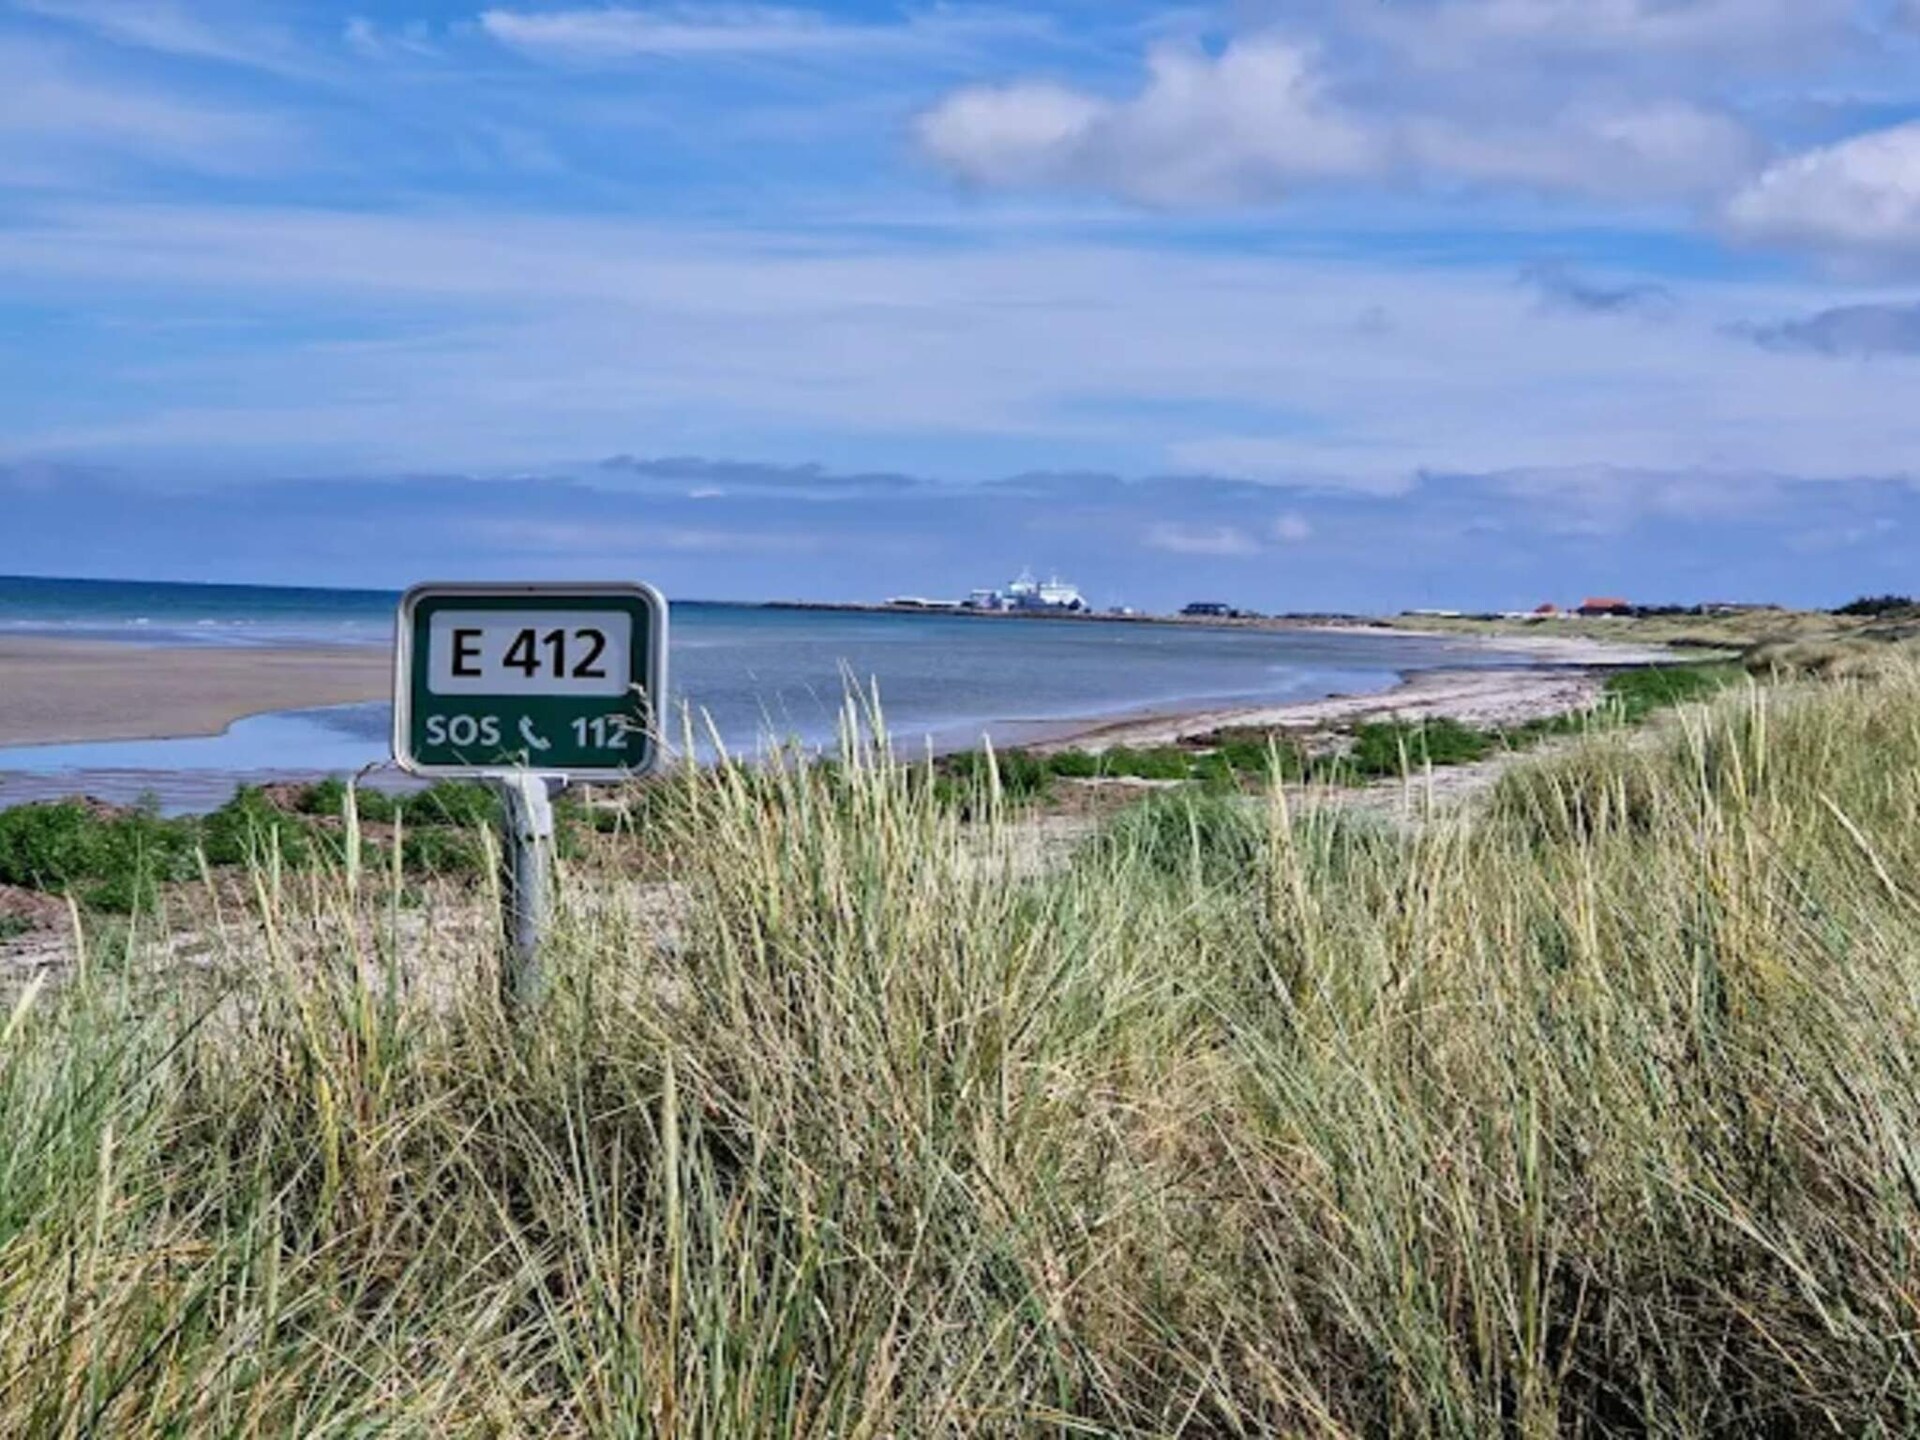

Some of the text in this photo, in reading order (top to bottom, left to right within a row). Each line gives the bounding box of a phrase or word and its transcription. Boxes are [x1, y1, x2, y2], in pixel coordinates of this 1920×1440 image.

[452, 628, 606, 678] E 412
[426, 714, 628, 748] SOS 112
